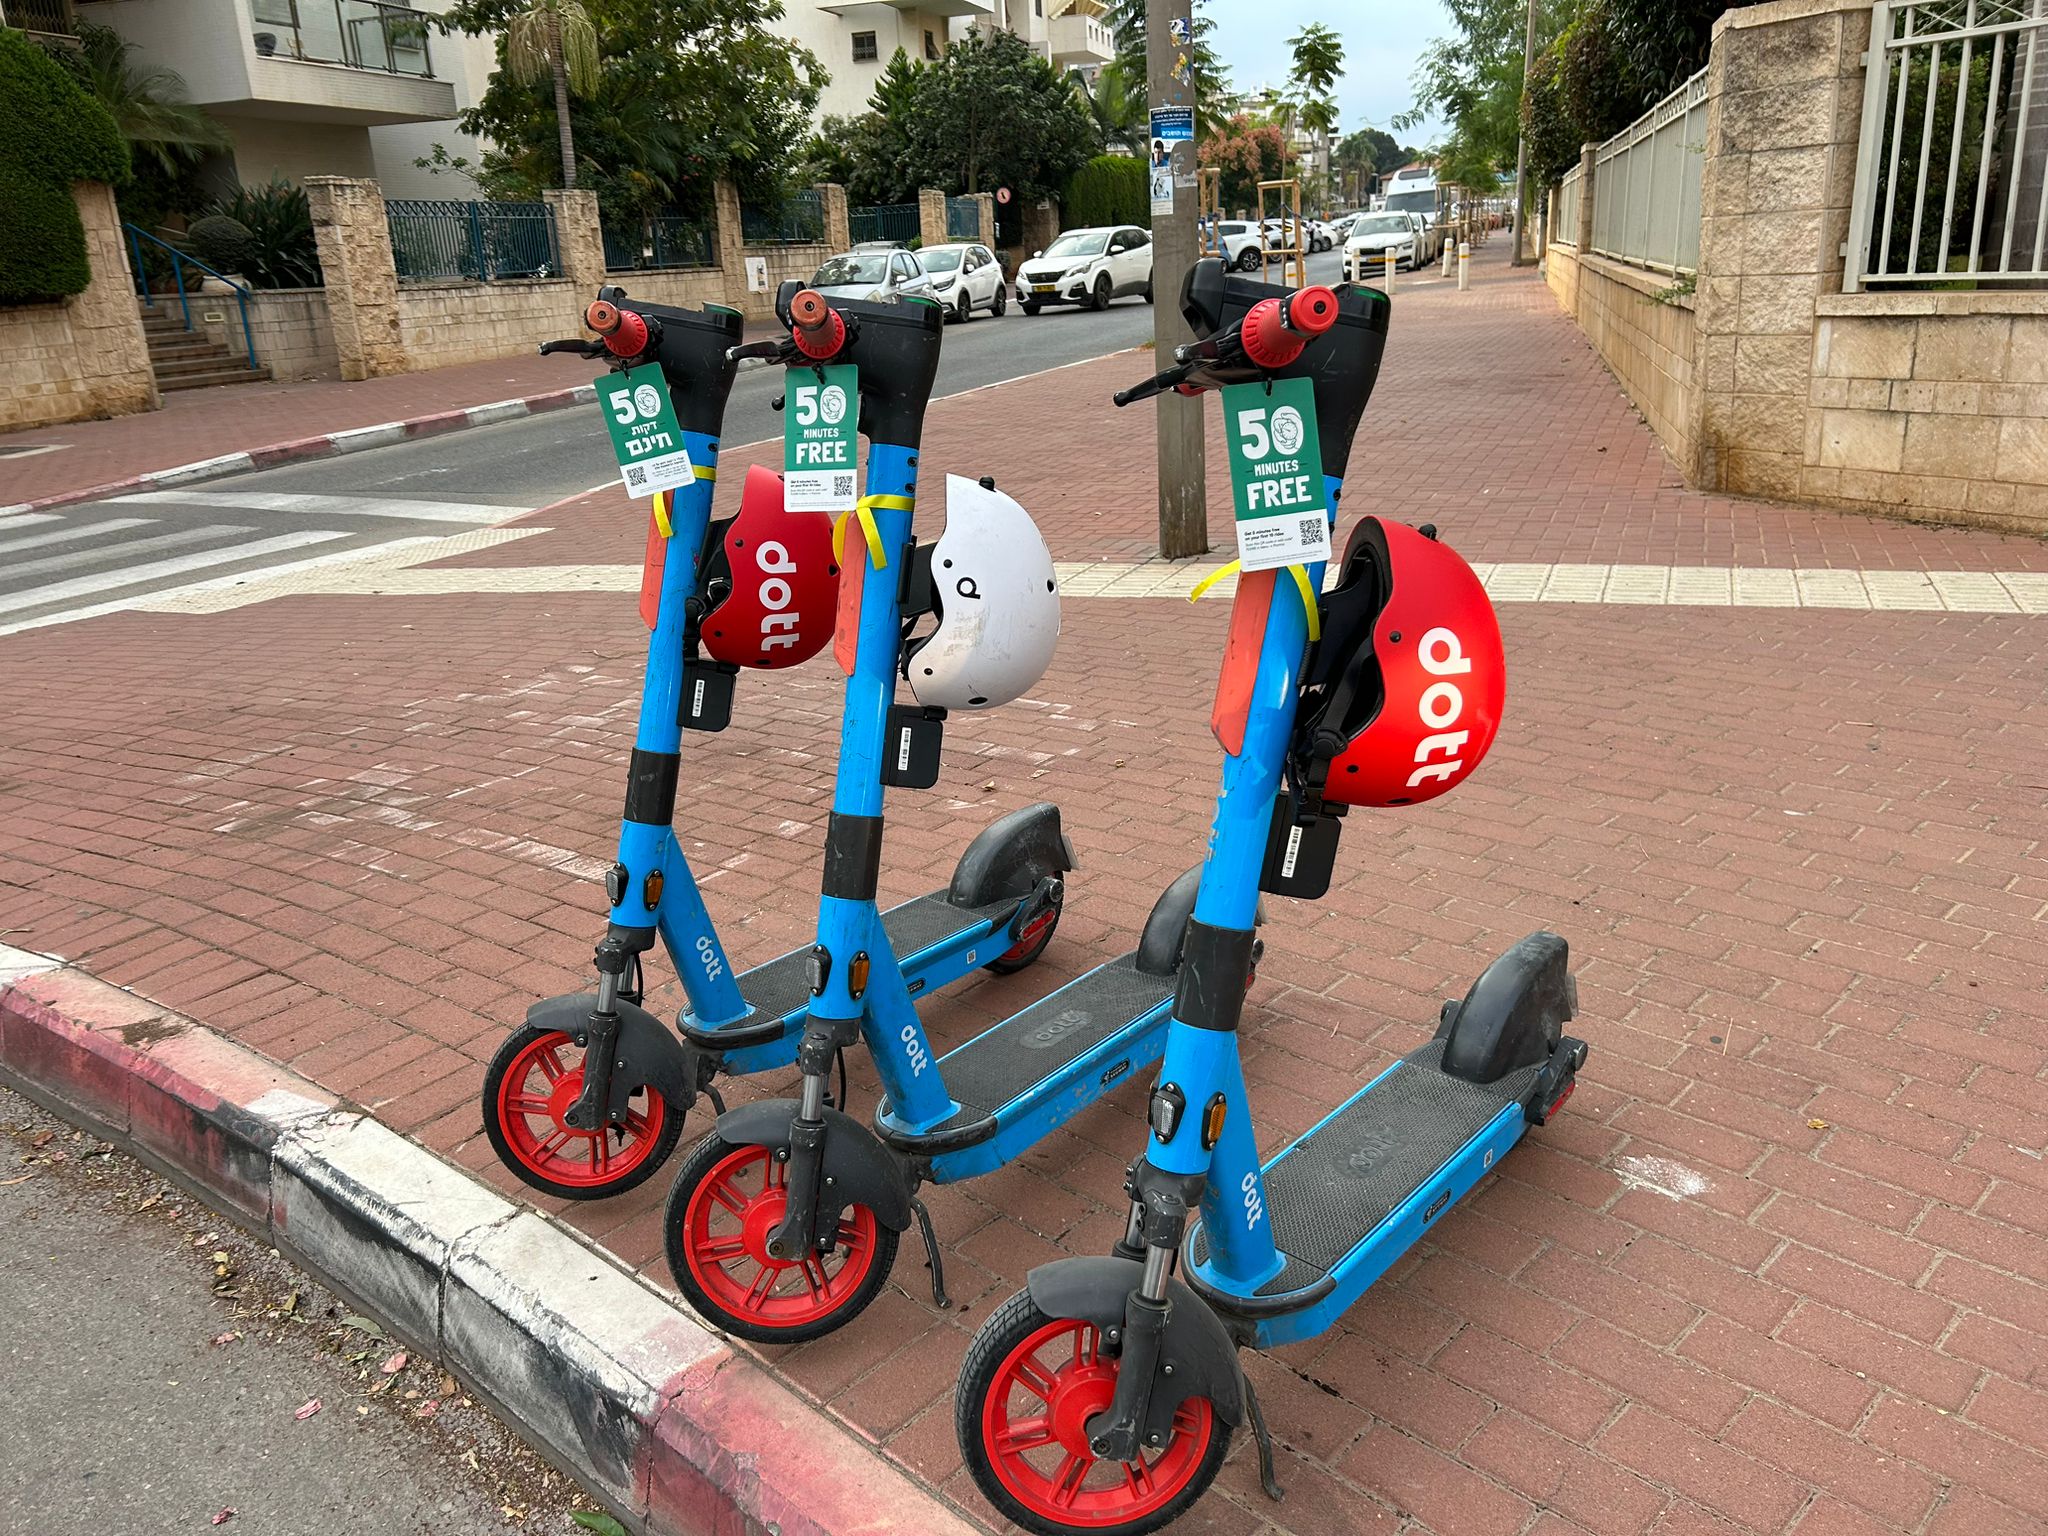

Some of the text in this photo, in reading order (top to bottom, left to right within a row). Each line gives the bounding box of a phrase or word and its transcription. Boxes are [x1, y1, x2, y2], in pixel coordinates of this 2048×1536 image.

[609, 384, 661, 425] 50
[796, 385, 847, 426] 50
[624, 432, 674, 457] חינם
[631, 421, 657, 436] דקות
[803, 428, 839, 438] MINUTES
[1238, 405, 1304, 460] 50
[796, 441, 847, 465] FREE
[1254, 459, 1300, 477] MINUTES
[1246, 475, 1313, 511] FREE
[755, 540, 801, 652] dott
[1406, 627, 1473, 788] dott
[696, 935, 723, 983] dott
[901, 1024, 928, 1078] dott
[1241, 1171, 1263, 1231] dott
